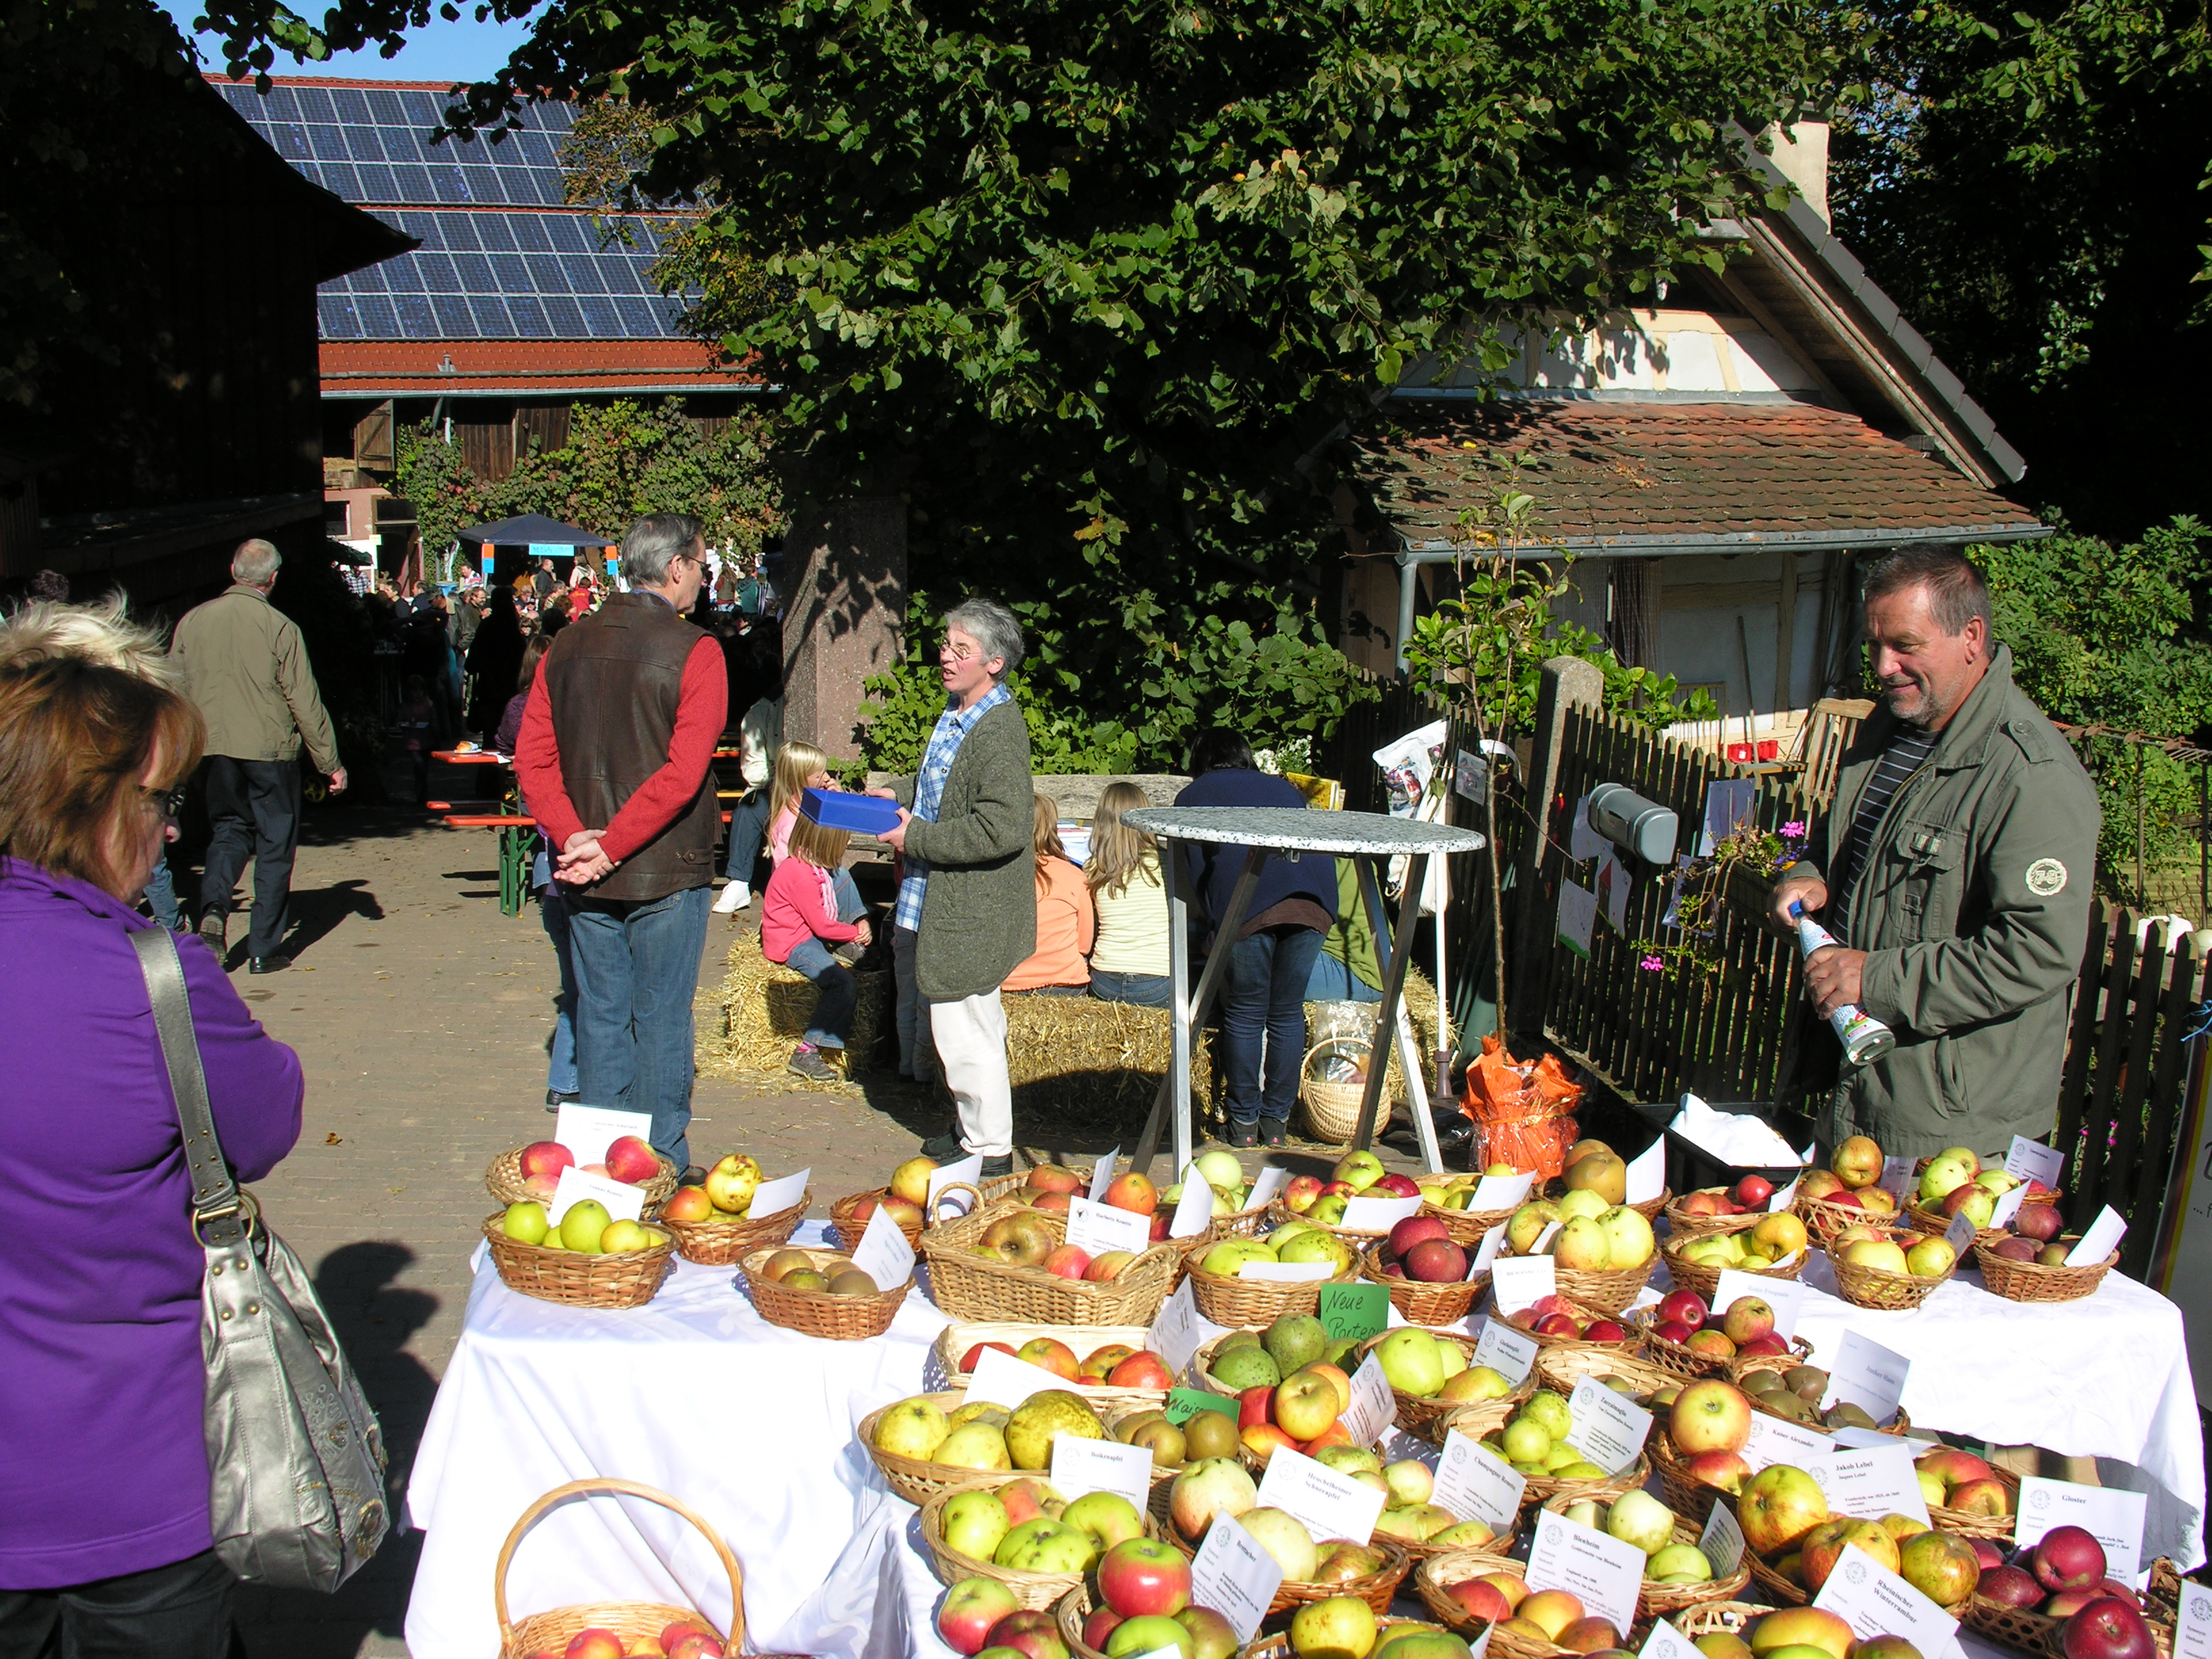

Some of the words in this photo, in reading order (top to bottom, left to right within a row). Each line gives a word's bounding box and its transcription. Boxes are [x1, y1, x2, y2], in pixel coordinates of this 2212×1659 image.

[1326, 1290, 1364, 1313] Neue
[1771, 1428, 1790, 1440] Kaiser
[1789, 1435, 1816, 1449] Alexander
[1090, 1451, 1124, 1462] Boikenapfel
[1835, 1462, 1856, 1472] Jakob
[1855, 1460, 1874, 1470] Lebel
[1305, 1480, 1341, 1501] Schneeapfel
[1307, 1471, 1353, 1497] Heuchelheimer
[2061, 1494, 2087, 1505] Gloster
[1572, 1533, 1601, 1550] Blenheim
[1877, 1578, 1914, 1610] Rheinischer
[1873, 1586, 1918, 1624] Winterrambur
